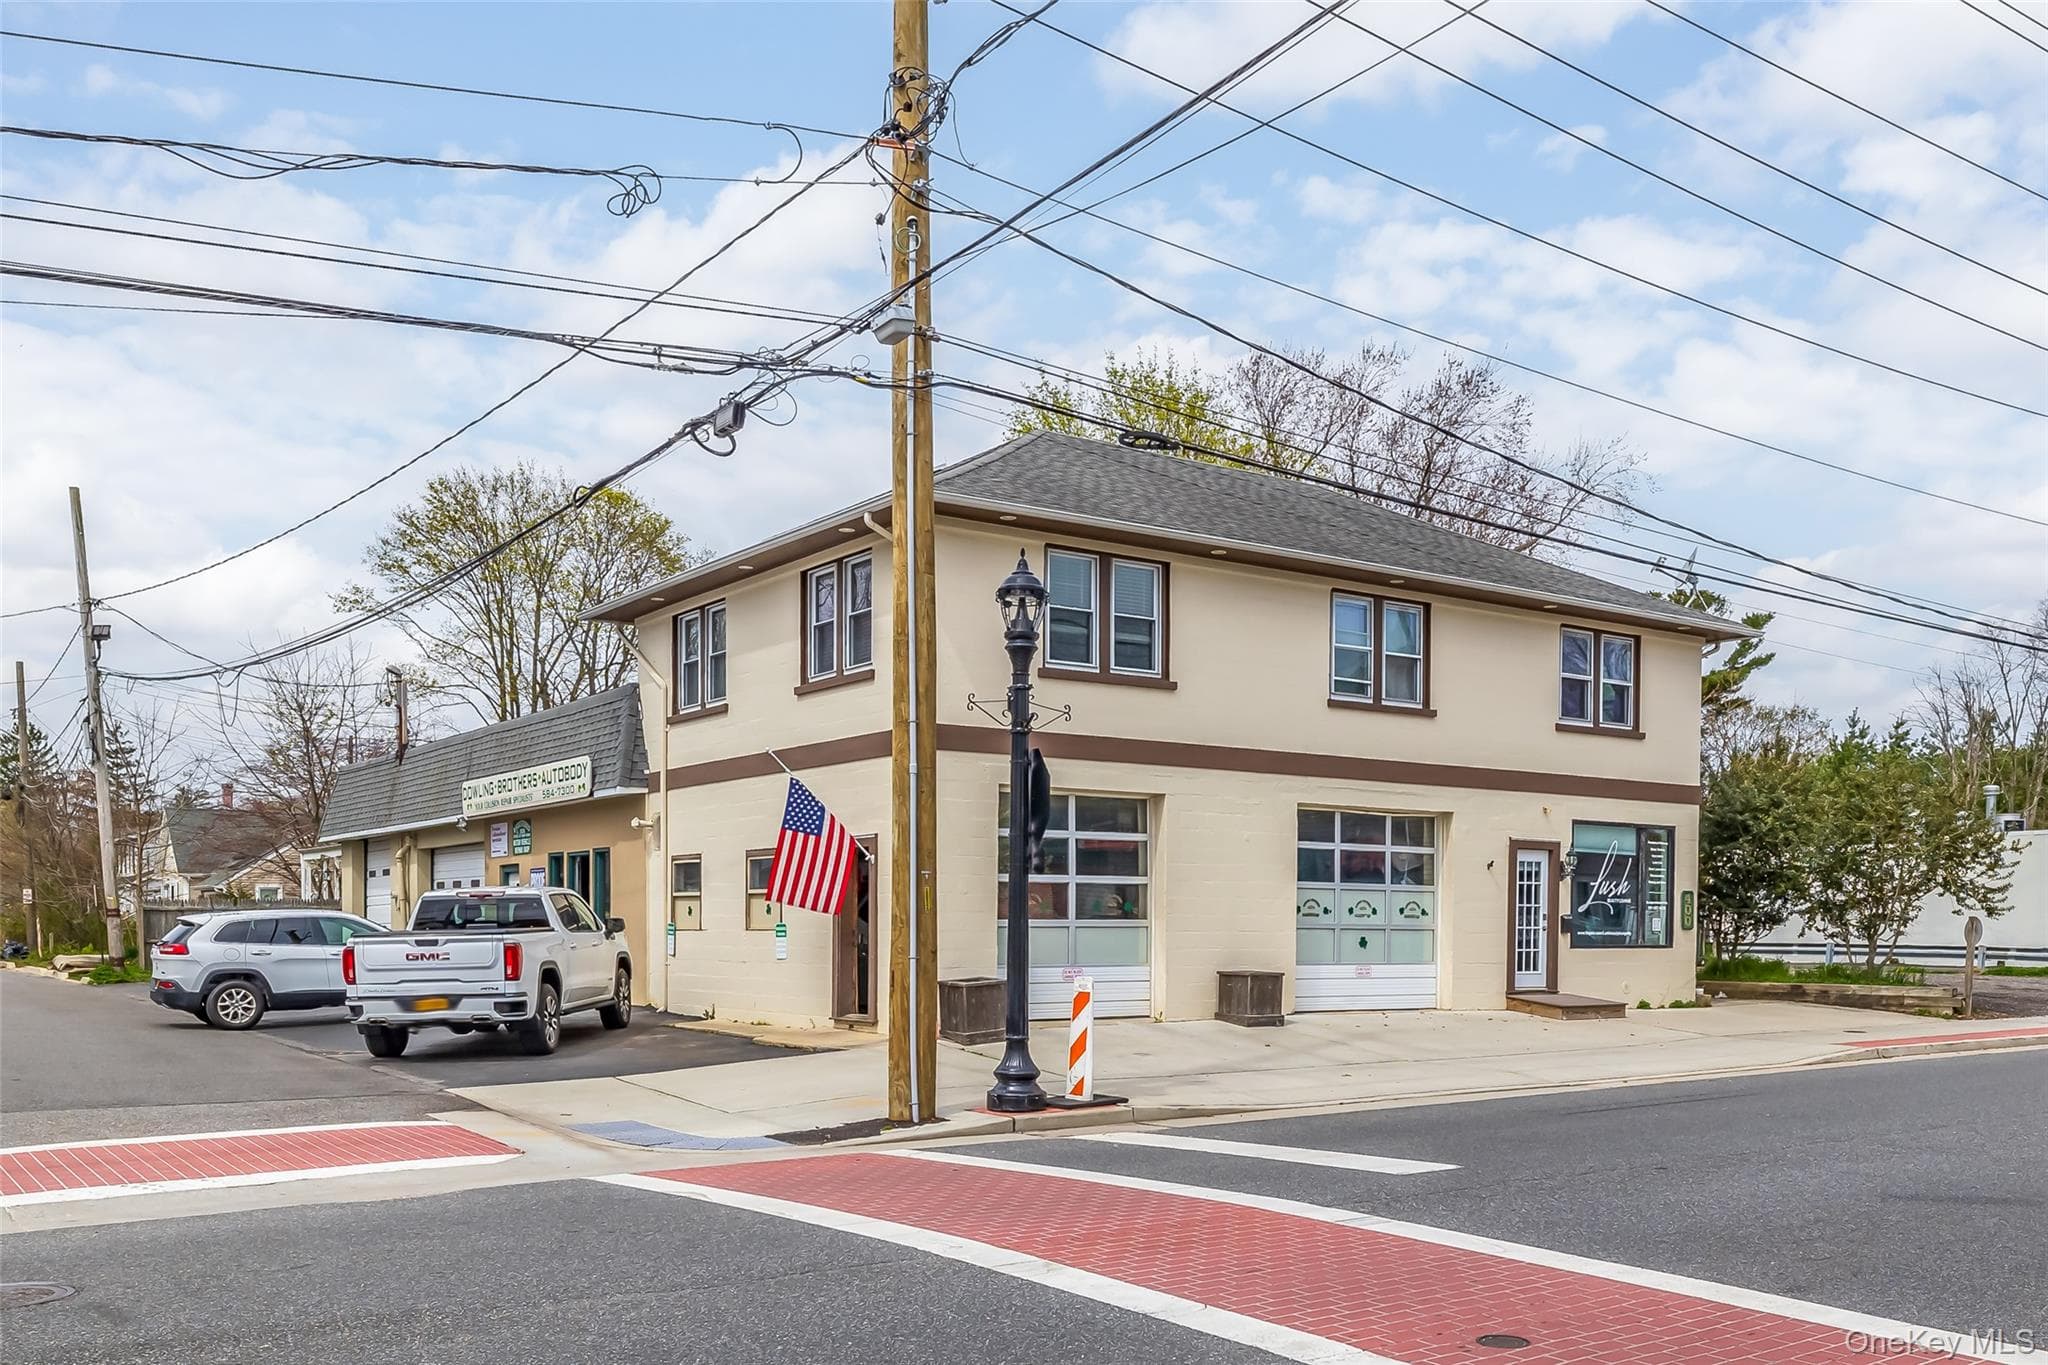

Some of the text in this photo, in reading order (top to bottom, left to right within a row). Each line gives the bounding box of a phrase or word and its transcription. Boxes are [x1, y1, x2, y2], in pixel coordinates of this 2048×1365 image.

[462, 761, 588, 801] DOWLING BROTHERS AUTOBODY
[1577, 840, 1632, 915] Lush
[405, 952, 450, 961] GMC
